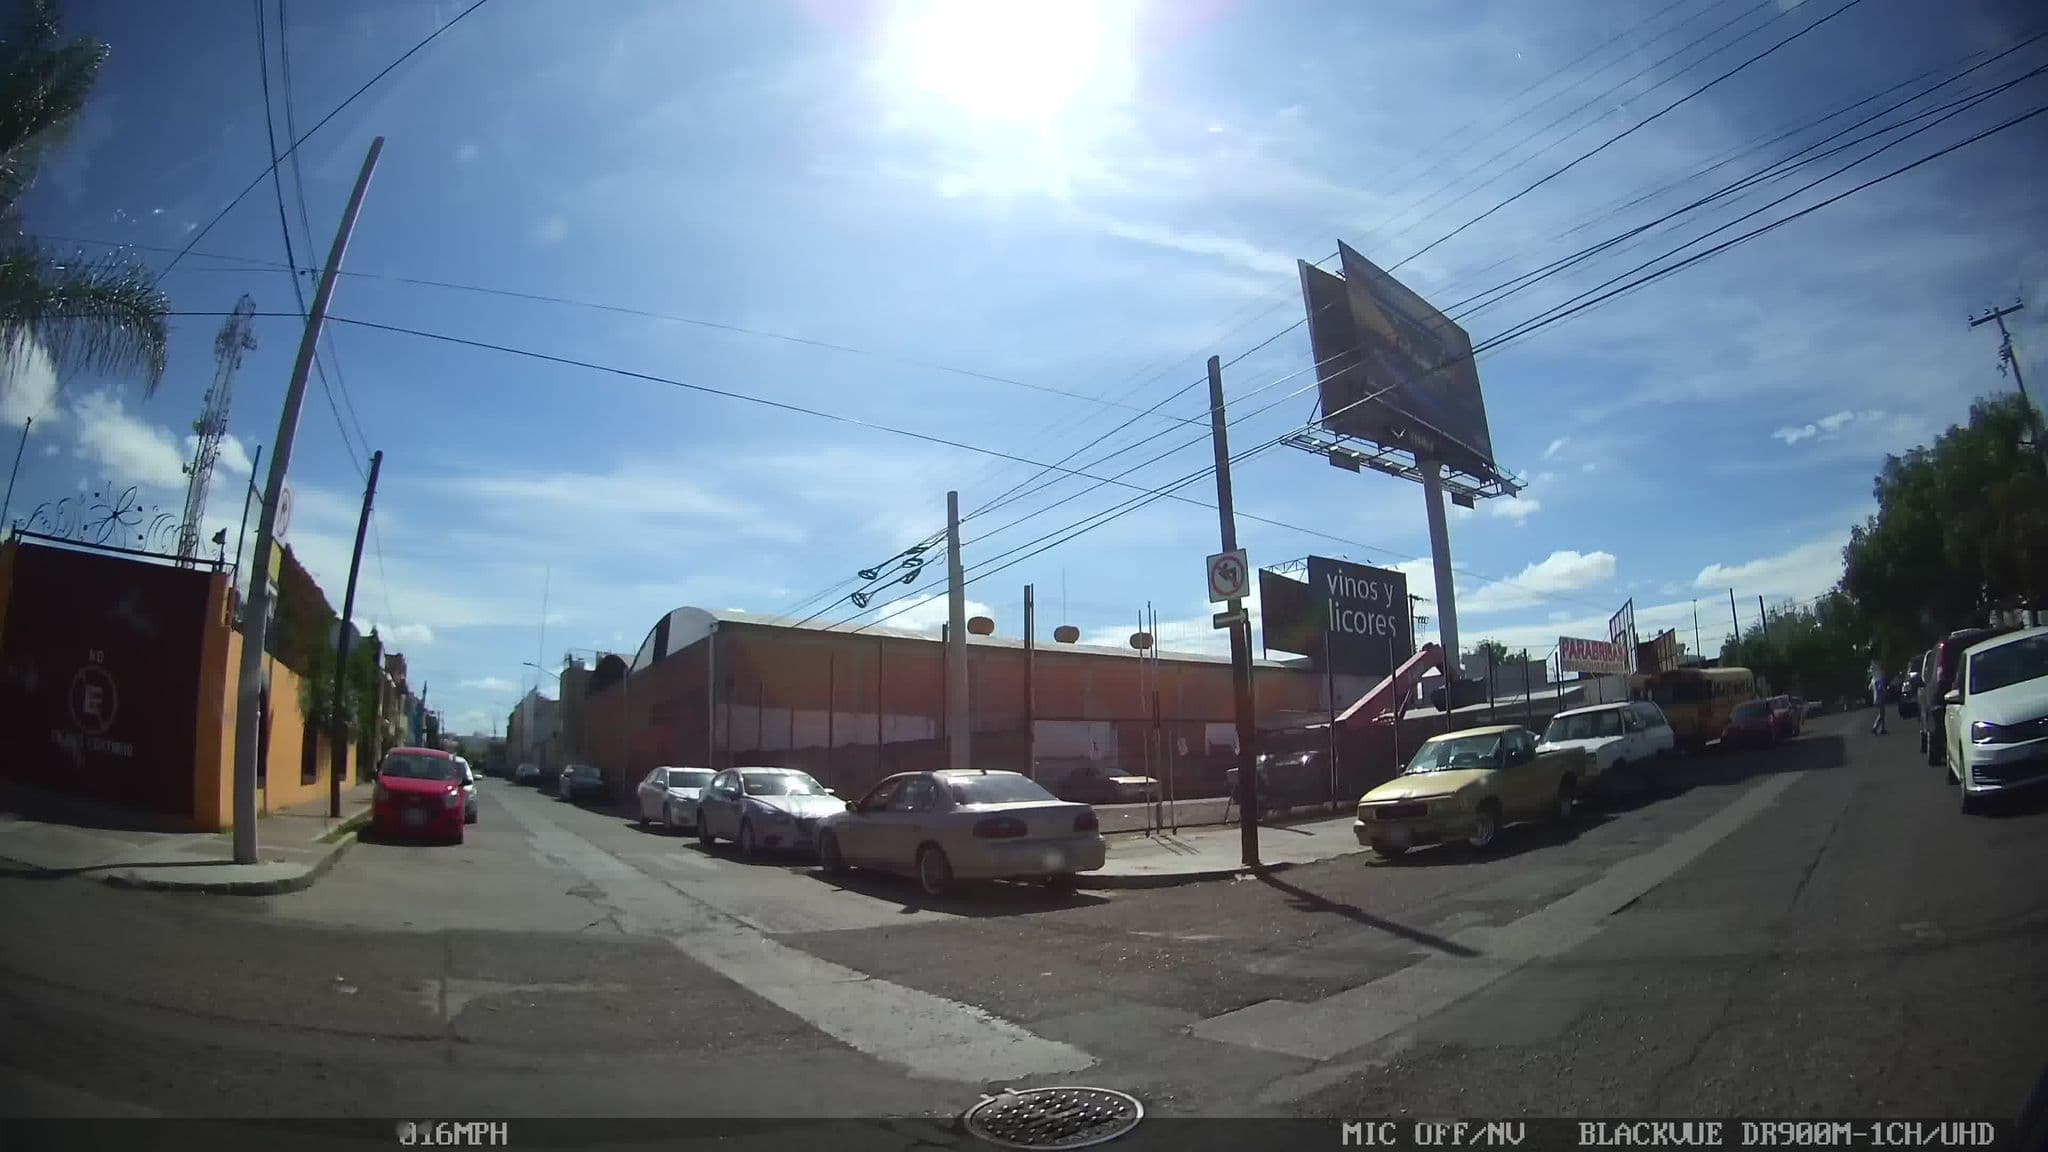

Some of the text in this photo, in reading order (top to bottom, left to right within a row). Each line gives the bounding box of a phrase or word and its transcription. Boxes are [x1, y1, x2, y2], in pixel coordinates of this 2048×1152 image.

[1326, 567, 1394, 609] vinos y
[1328, 597, 1397, 638] licores
[88, 647, 105, 664] NO
